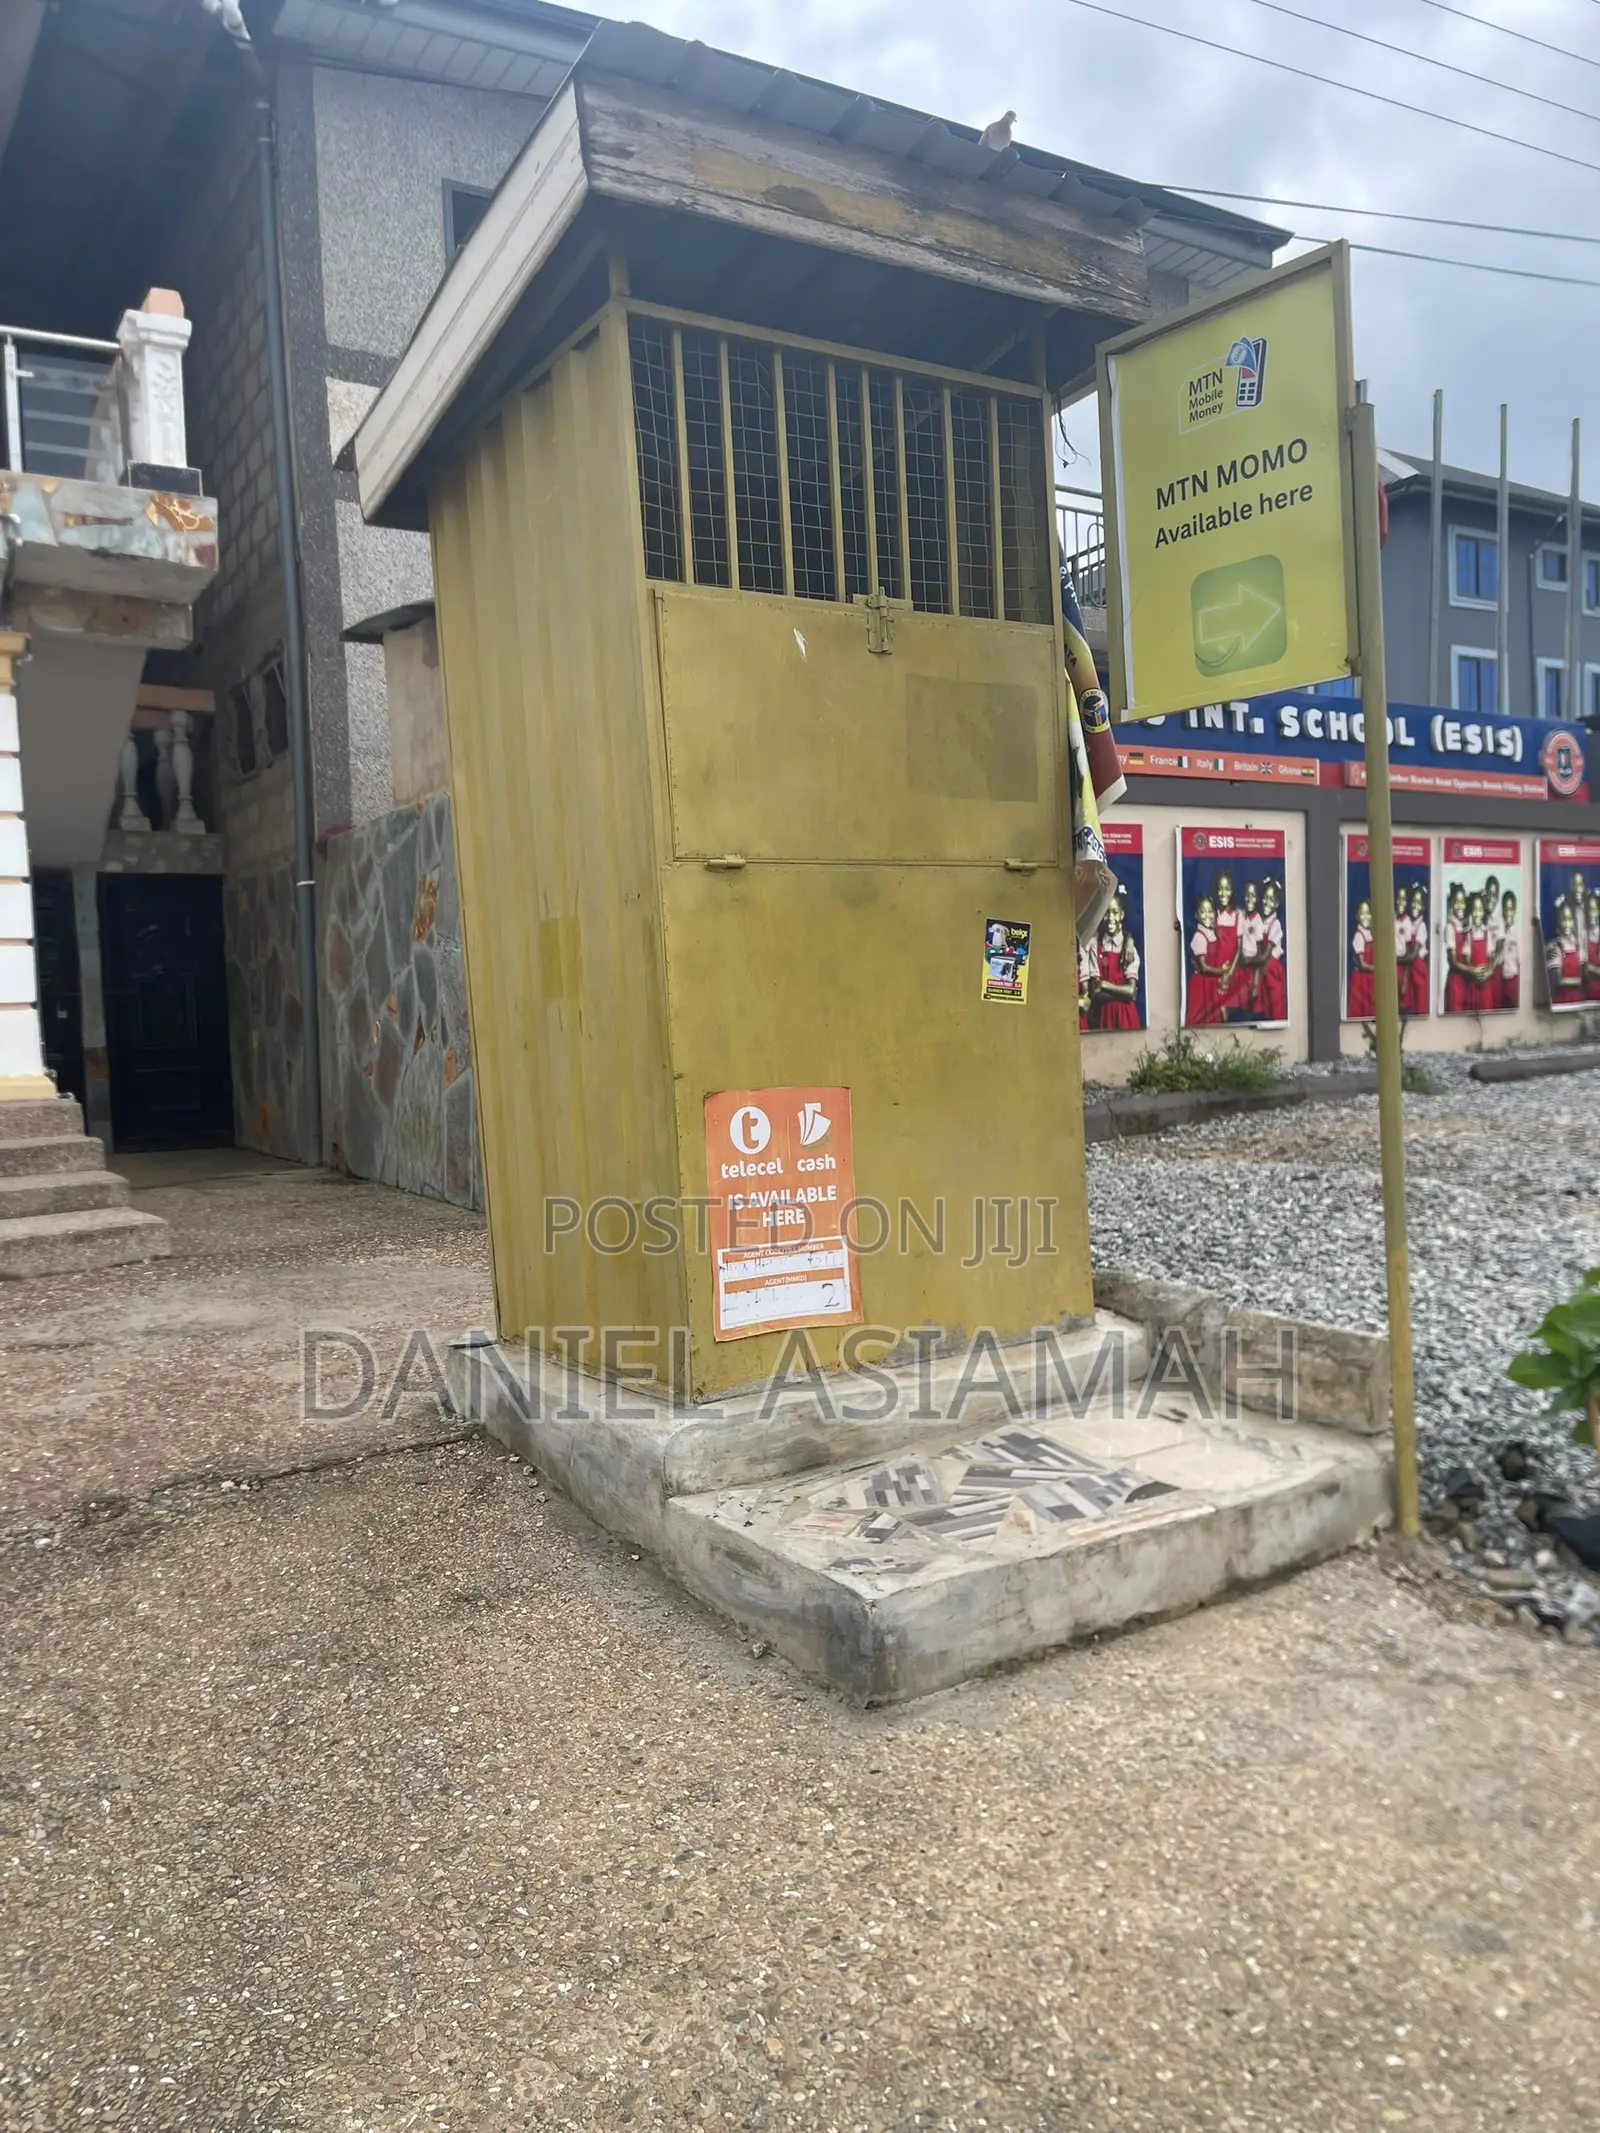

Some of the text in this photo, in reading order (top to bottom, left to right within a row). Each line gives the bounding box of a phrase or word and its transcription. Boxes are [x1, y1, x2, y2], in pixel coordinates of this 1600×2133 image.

[1189, 368, 1223, 396] MTN
[1189, 388, 1224, 410] Mobile
[1189, 402, 1224, 423] Money
[1156, 438, 1308, 510] MTN MOMO
[1155, 484, 1314, 549] Available here
[1187, 702, 1265, 734] INT.
[1431, 714, 1523, 763] (ESIS)
[1150, 755, 1178, 767] France
[1197, 759, 1214, 771] Italy
[1234, 761, 1259, 772] Britain
[1278, 765, 1301, 775] Ghana
[1209, 835, 1235, 849] ESIS
[721, 1154, 836, 1179] telecel cash
[728, 1184, 837, 1210] IS AVAILABLE
[762, 1207, 805, 1228] HERE
[743, 1250, 764, 1259] AGENT
[798, 1243, 825, 1253] NUMBER
